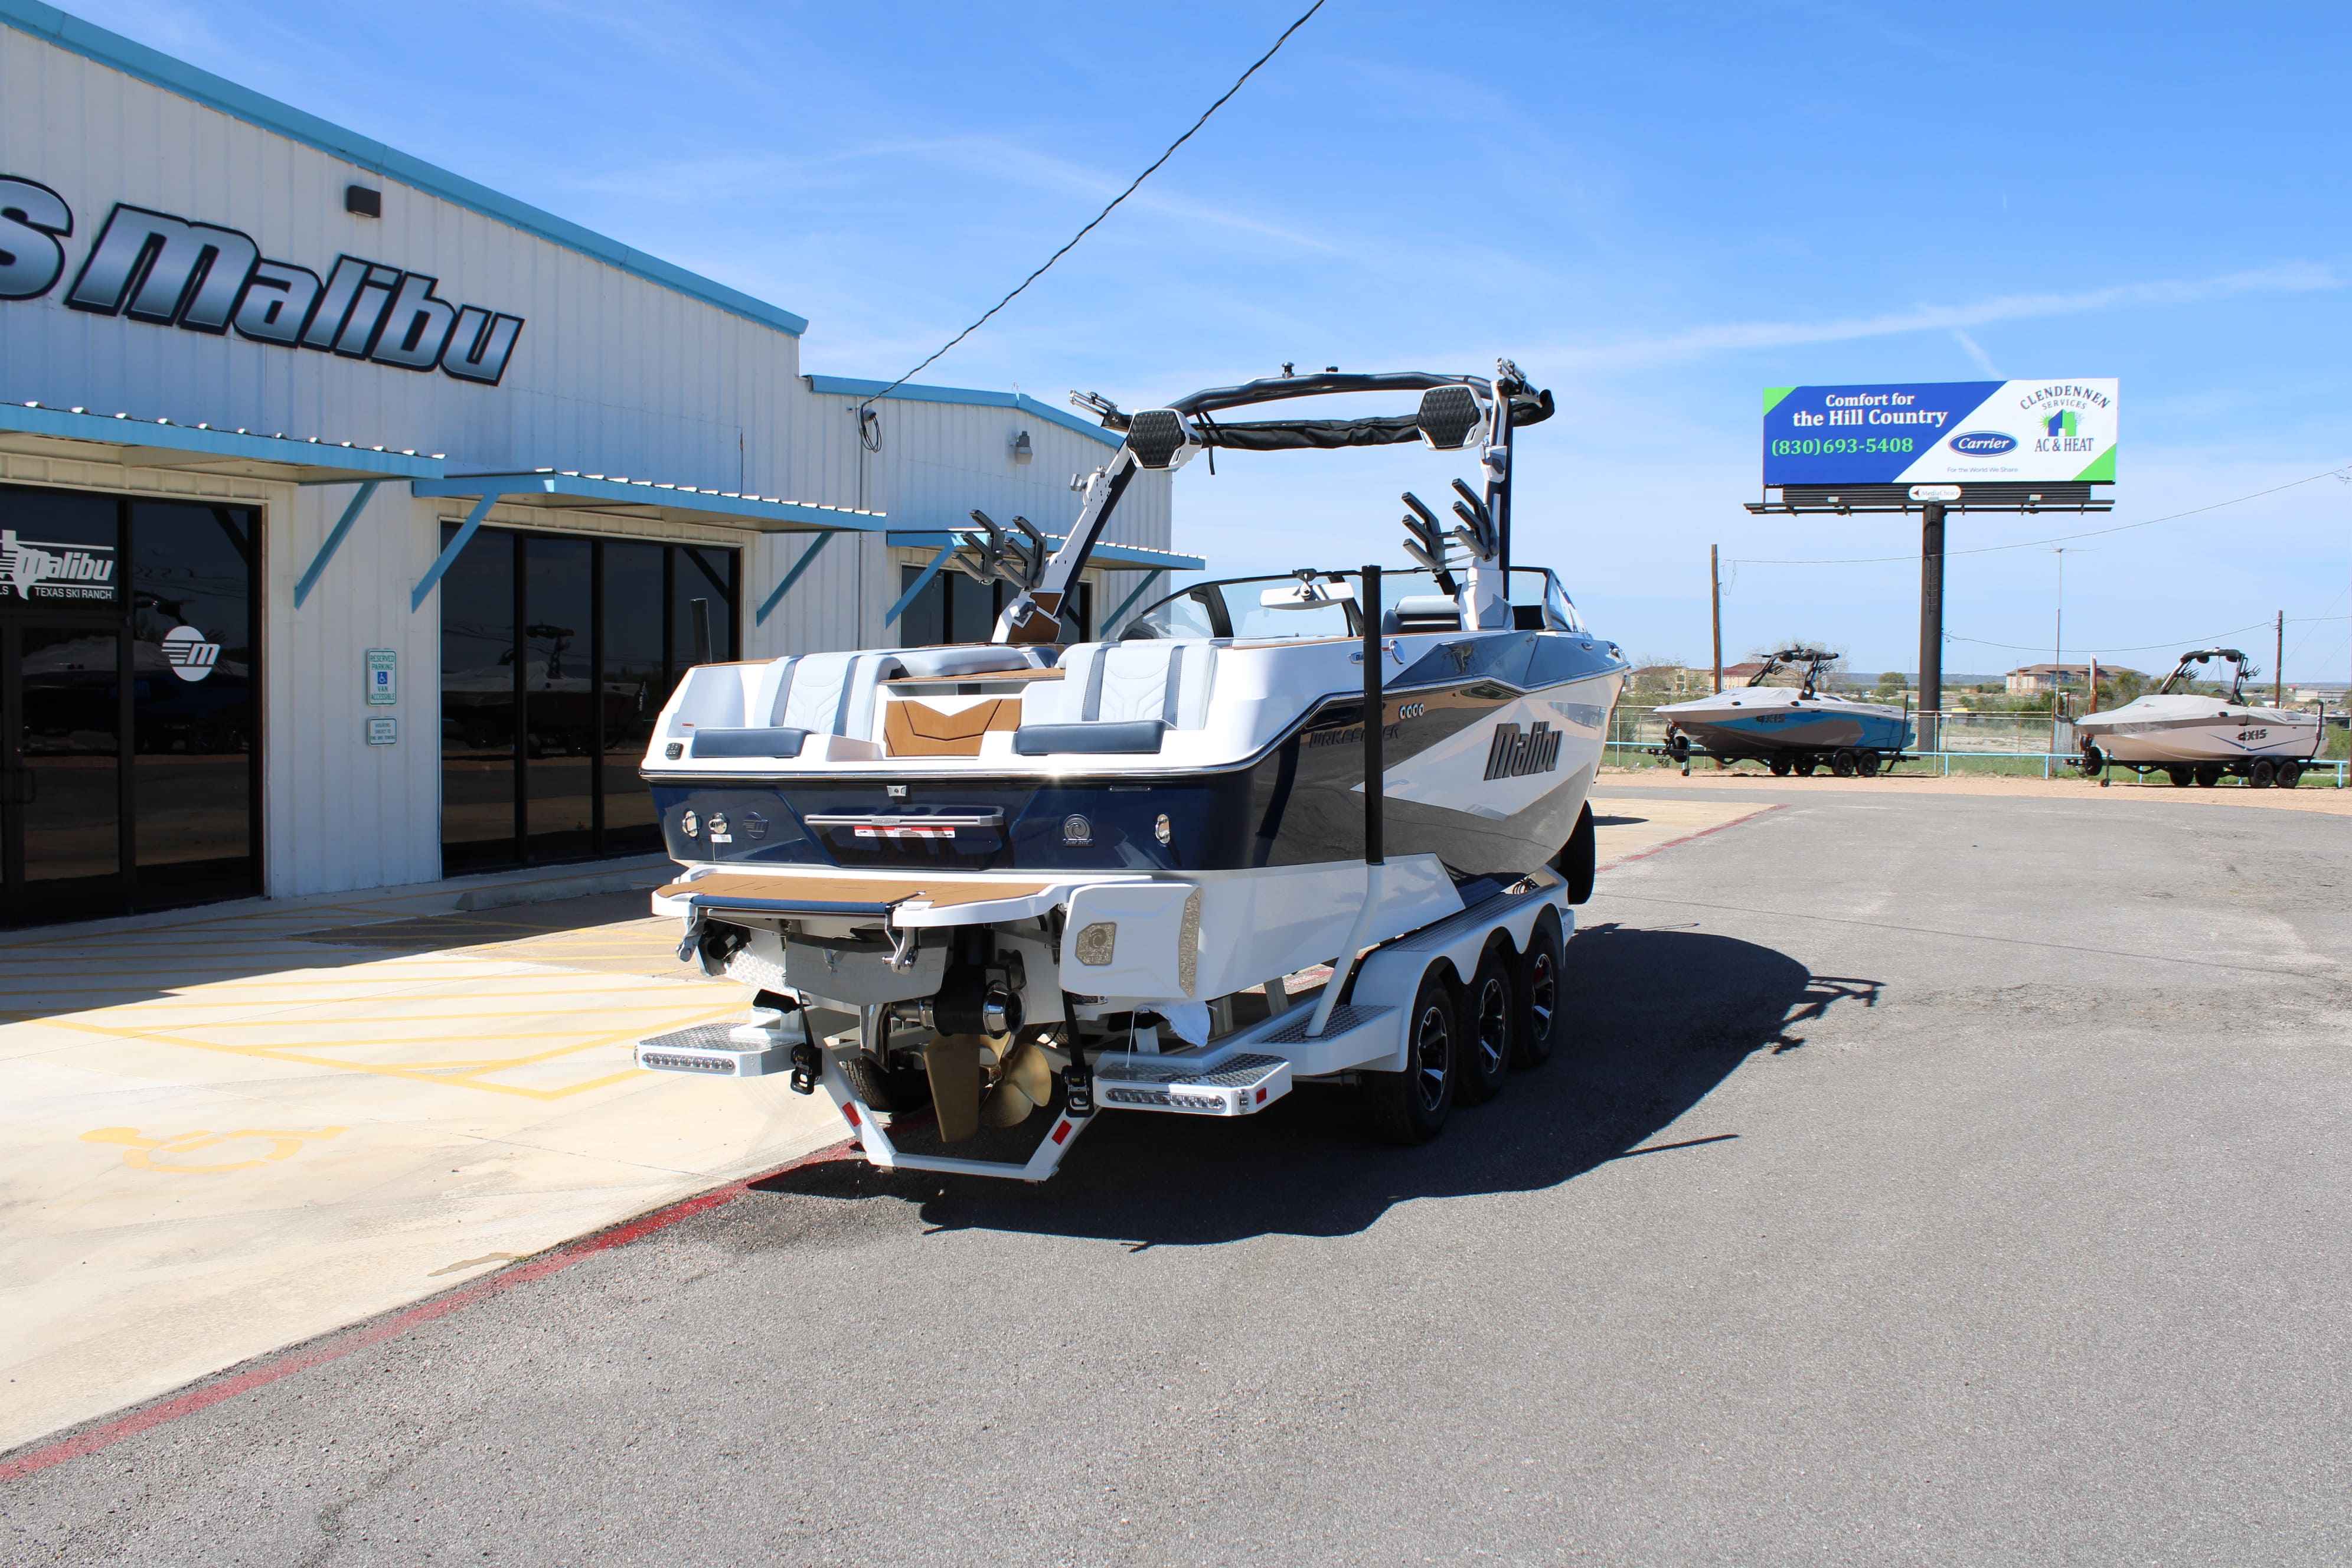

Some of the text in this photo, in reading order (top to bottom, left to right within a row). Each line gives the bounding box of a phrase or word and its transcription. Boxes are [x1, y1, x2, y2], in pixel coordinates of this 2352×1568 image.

[63, 202, 525, 386] Malibu
[1826, 393, 1915, 407] Comfort for
[2020, 386, 2111, 409] CLENDENNEN
[2042, 399, 2088, 410] SERVICES
[1793, 409, 1948, 428] the Hill Country
[1958, 438, 2009, 449] Carrier
[2035, 438, 2094, 452] AC & HEAT
[14, 548, 113, 581] Malibu
[34, 587, 112, 599] TEXAS SKI RANCH
[2237, 729, 2267, 741] AXIS
[1483, 721, 1563, 781] Malibu
